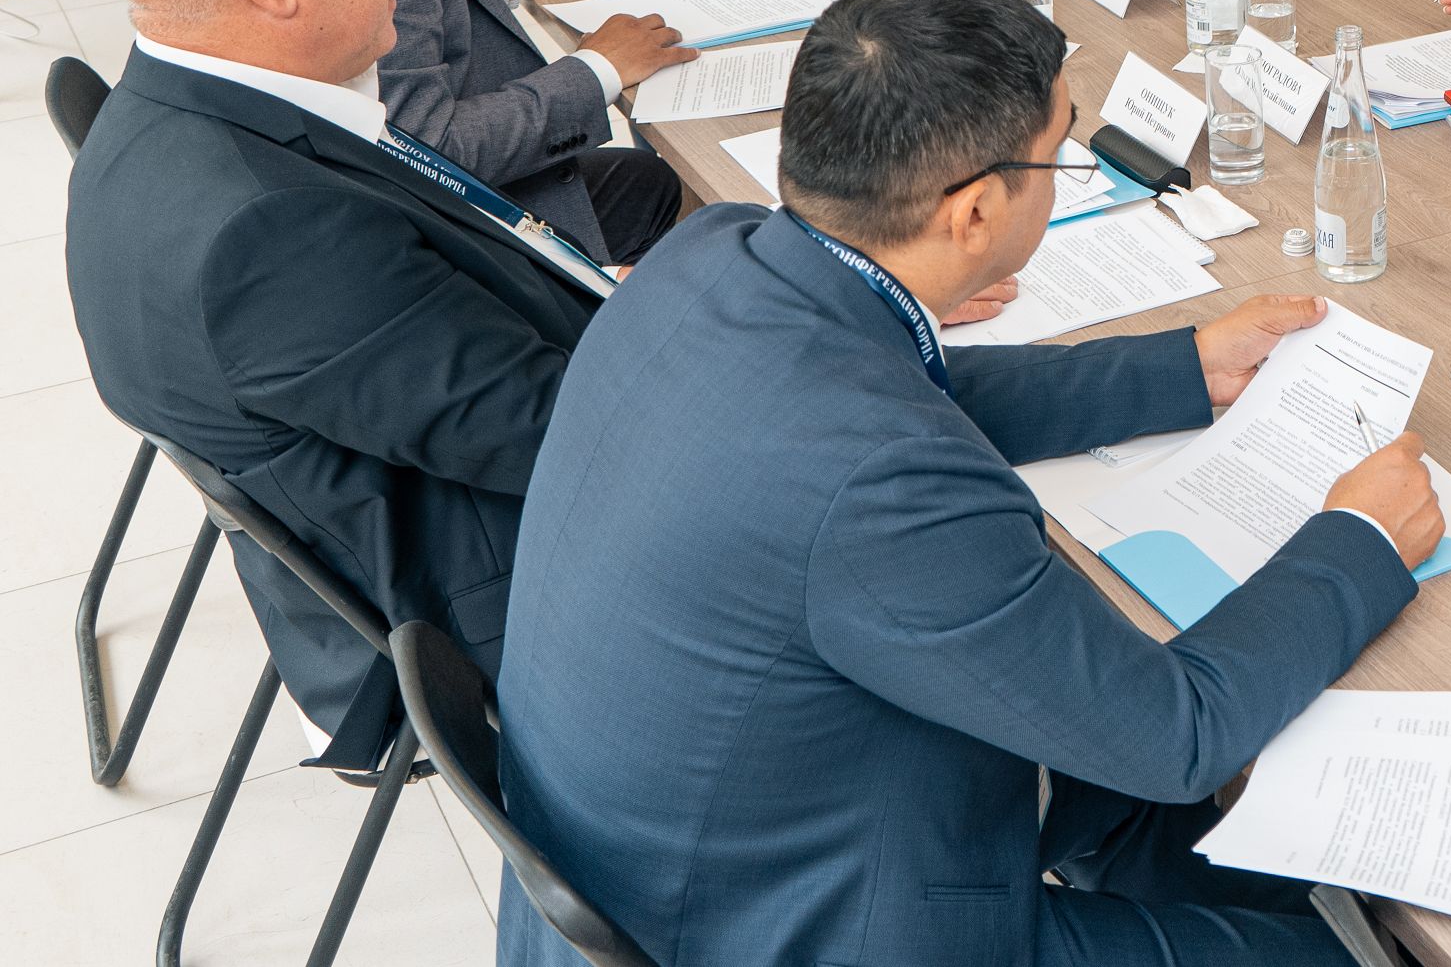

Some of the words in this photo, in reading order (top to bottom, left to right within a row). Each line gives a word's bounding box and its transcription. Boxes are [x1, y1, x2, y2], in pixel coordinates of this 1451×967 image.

[1124, 97, 1146, 120] Юрий
[1144, 111, 1176, 142] Петрович
[1140, 88, 1176, 119] ОНИЩУК
[439, 173, 467, 196] ЮРПА
[916, 319, 935, 365] ЮРПА
